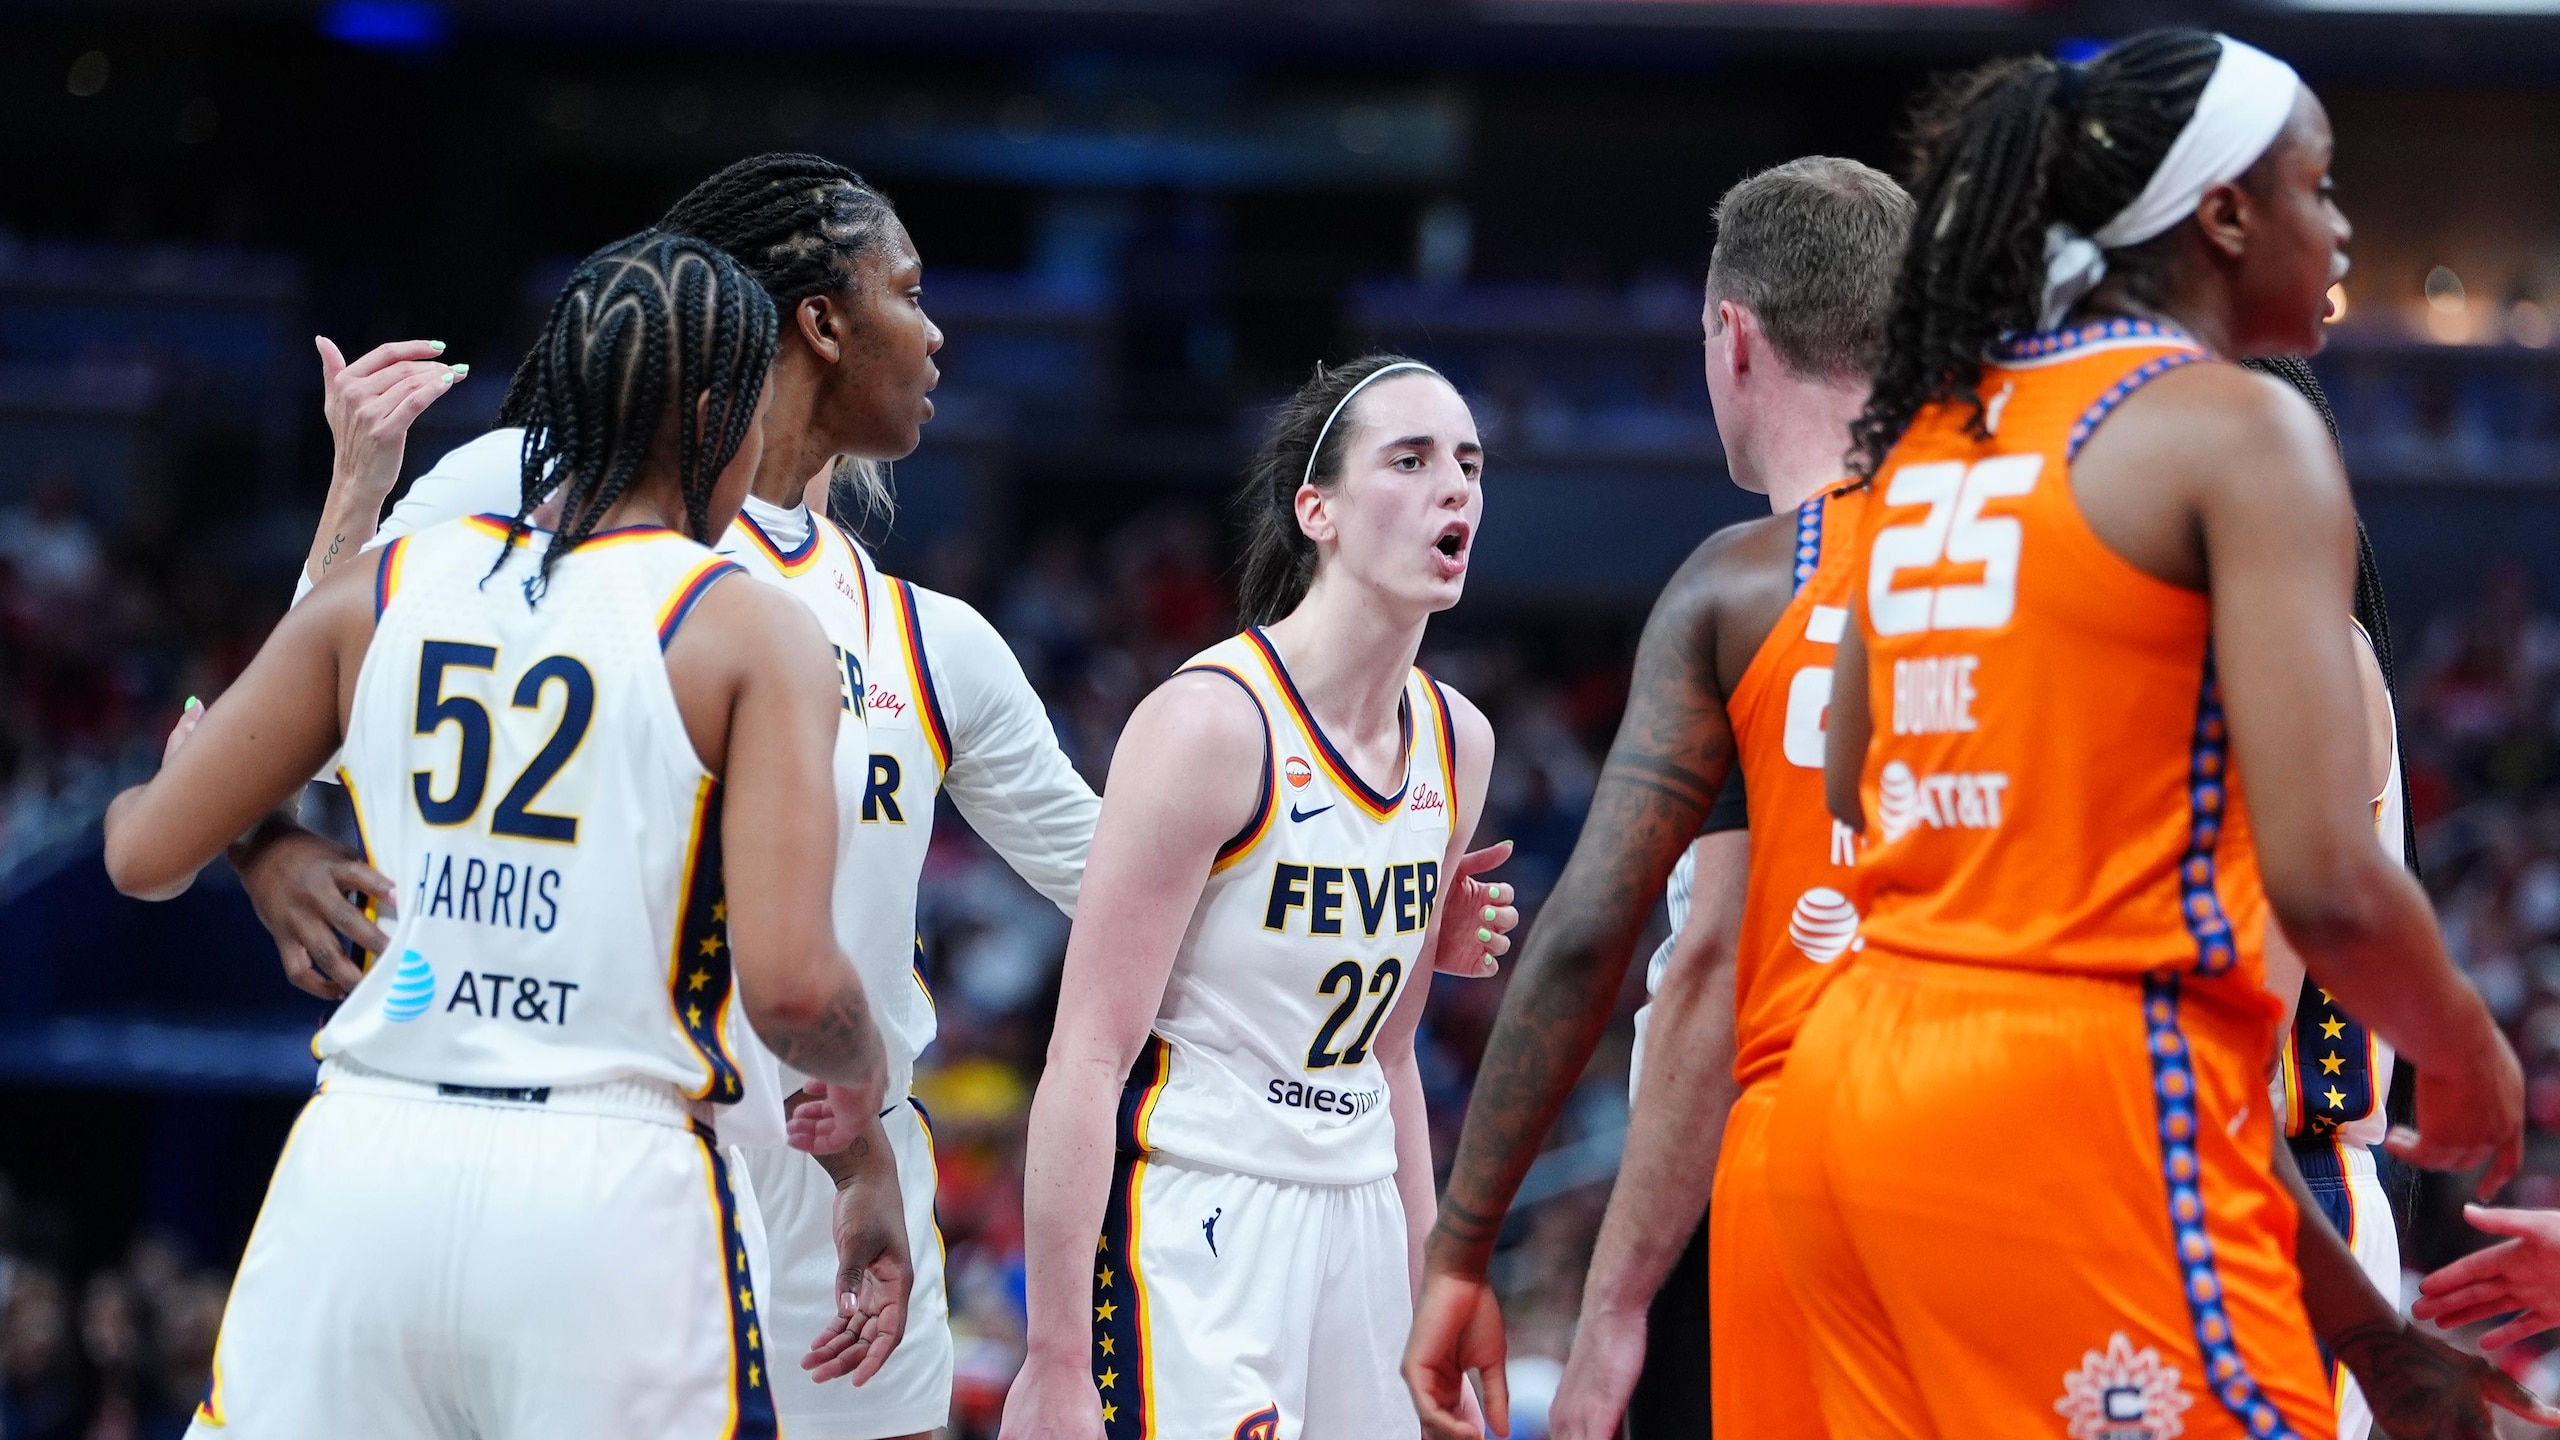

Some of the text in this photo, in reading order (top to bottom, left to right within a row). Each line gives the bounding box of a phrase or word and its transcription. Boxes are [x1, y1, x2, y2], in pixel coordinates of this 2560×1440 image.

[1867, 453, 2044, 638] 25
[1893, 655, 1980, 735] BURKE
[411, 638, 599, 847] 52
[1410, 782, 1445, 817] Lilly
[1912, 772, 2010, 829] AT&T
[1263, 859, 1438, 938] FEVER
[446, 970, 579, 1026] AT&T
[1303, 955, 1403, 1073] 22
